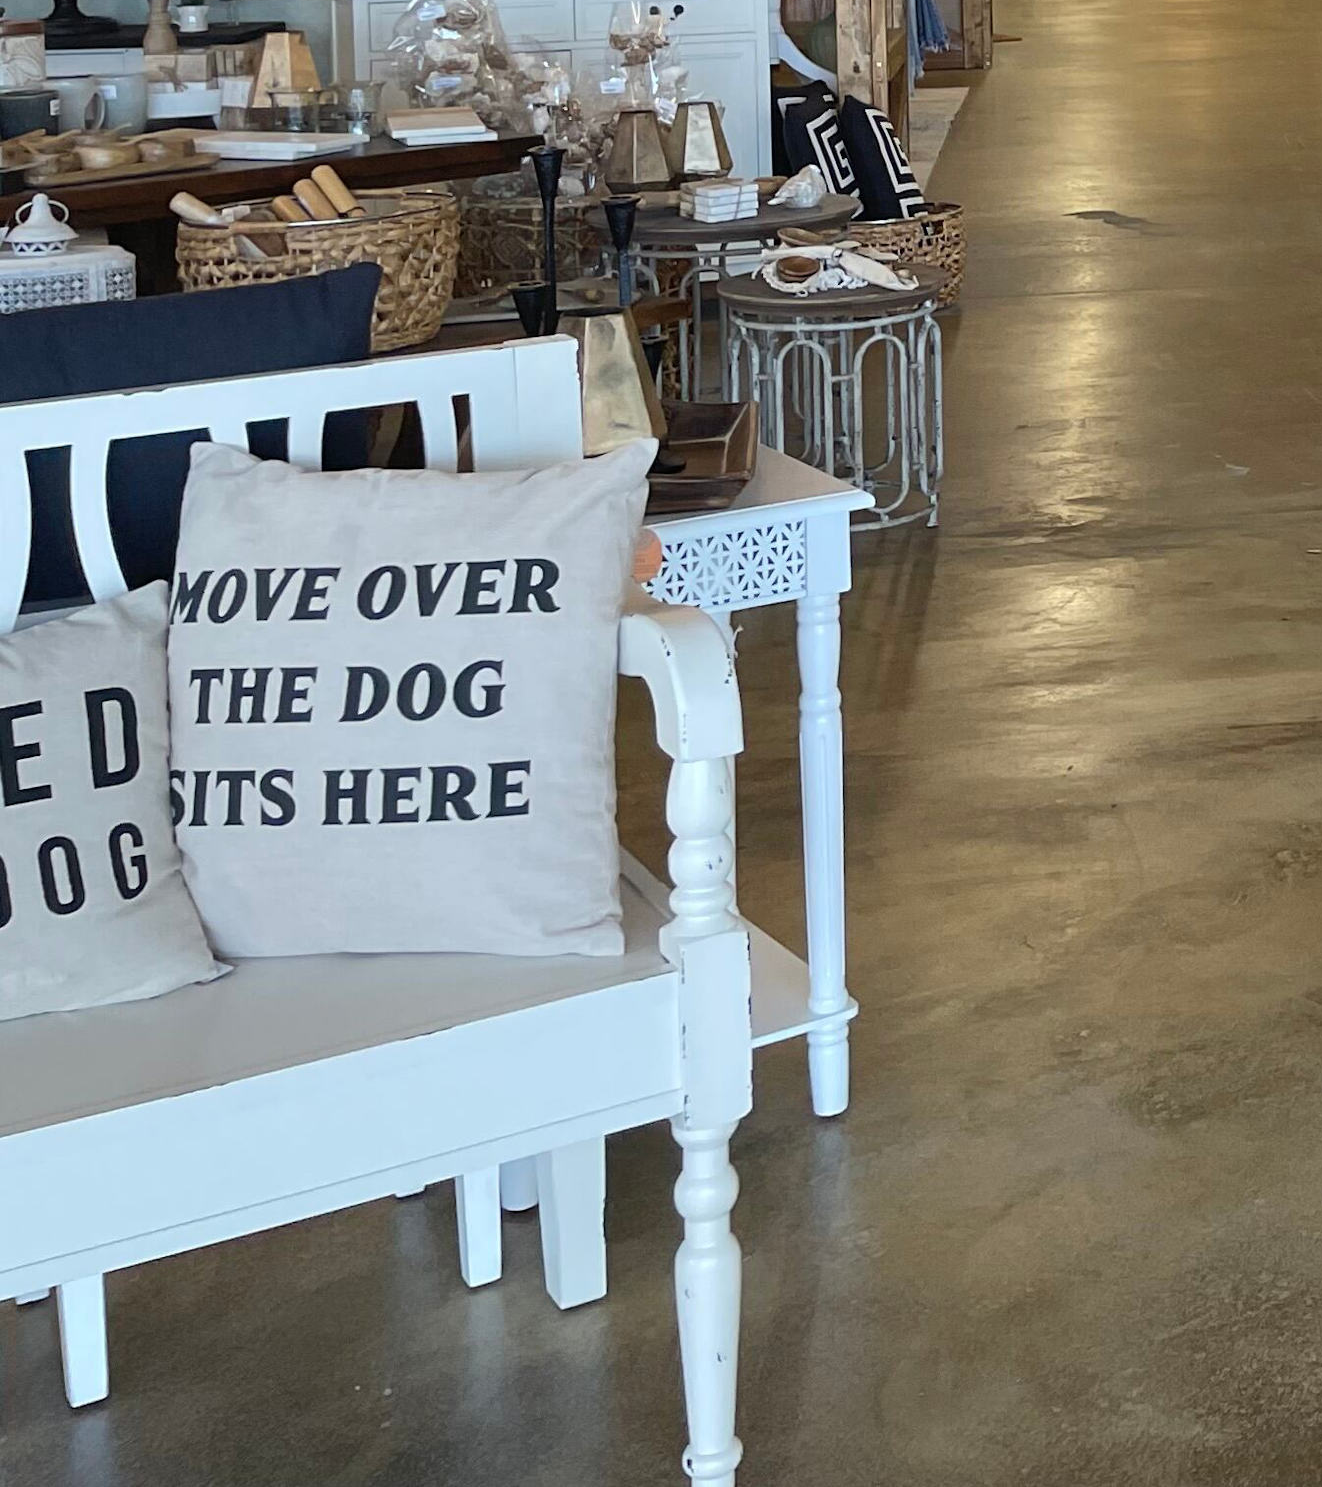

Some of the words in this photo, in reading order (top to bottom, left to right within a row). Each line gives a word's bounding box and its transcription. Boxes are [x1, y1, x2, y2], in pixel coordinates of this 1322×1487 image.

[170, 565, 342, 626] MOVE
[356, 557, 562, 621] OVER
[188, 666, 319, 725] THE
[339, 659, 506, 723] DOG
[169, 767, 297, 828] SITS
[321, 759, 532, 826] HERE
